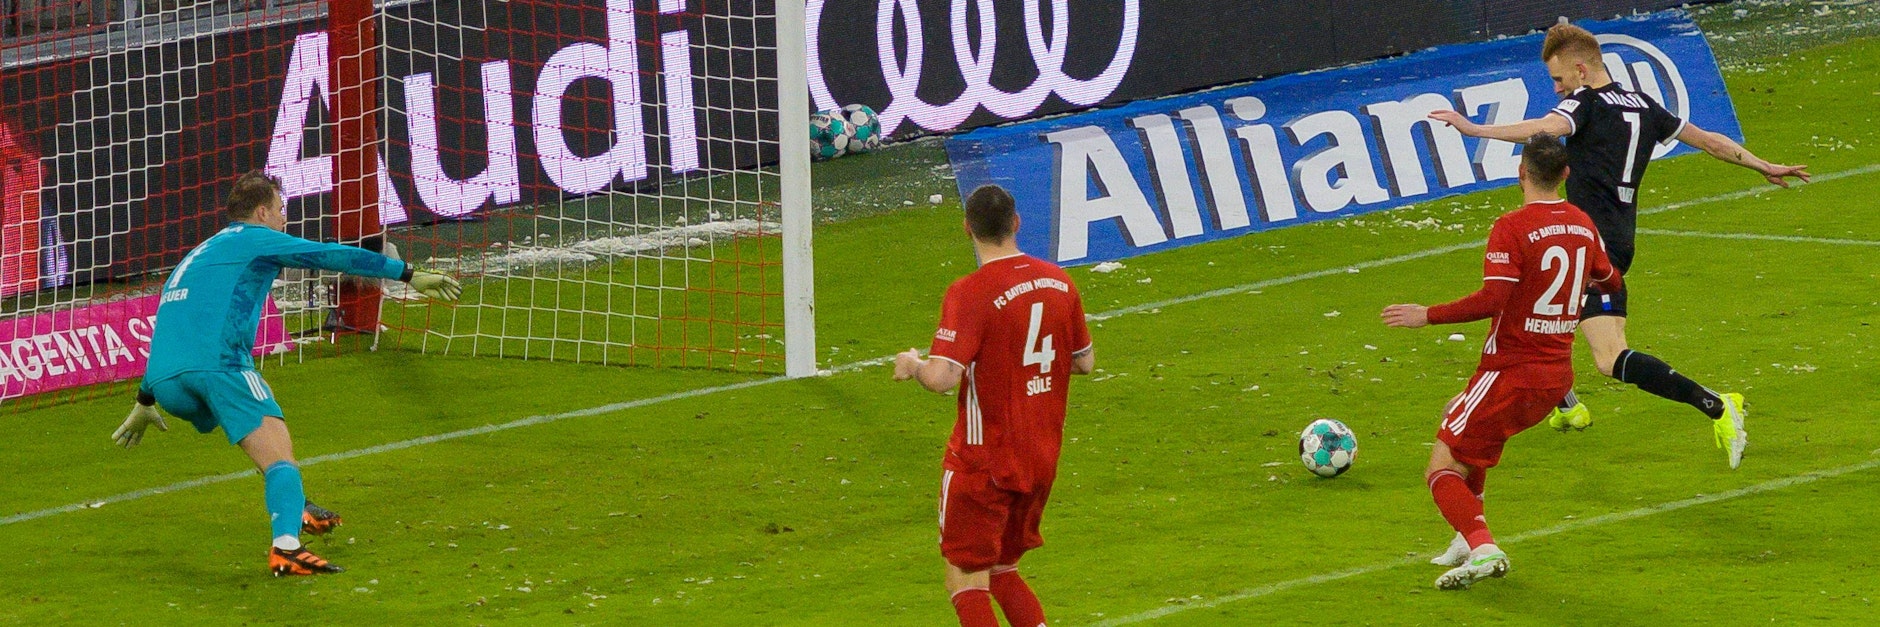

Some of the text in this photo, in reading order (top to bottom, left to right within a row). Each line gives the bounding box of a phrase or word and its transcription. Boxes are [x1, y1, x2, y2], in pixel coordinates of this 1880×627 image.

[263, 0, 698, 226] Audi
[1044, 77, 1531, 263] Allianz
[1528, 231, 1541, 243] FC
[1539, 224, 1566, 238] BAYERN
[993, 295, 1007, 310] FC
[1004, 280, 1034, 301] BAYERN
[1533, 245, 1587, 315] 21
[936, 327, 957, 339] ATAR
[1023, 302, 1056, 374] 4
[1524, 316, 1580, 335] HERNÁNDE
[1026, 375, 1052, 397] SÜLE
